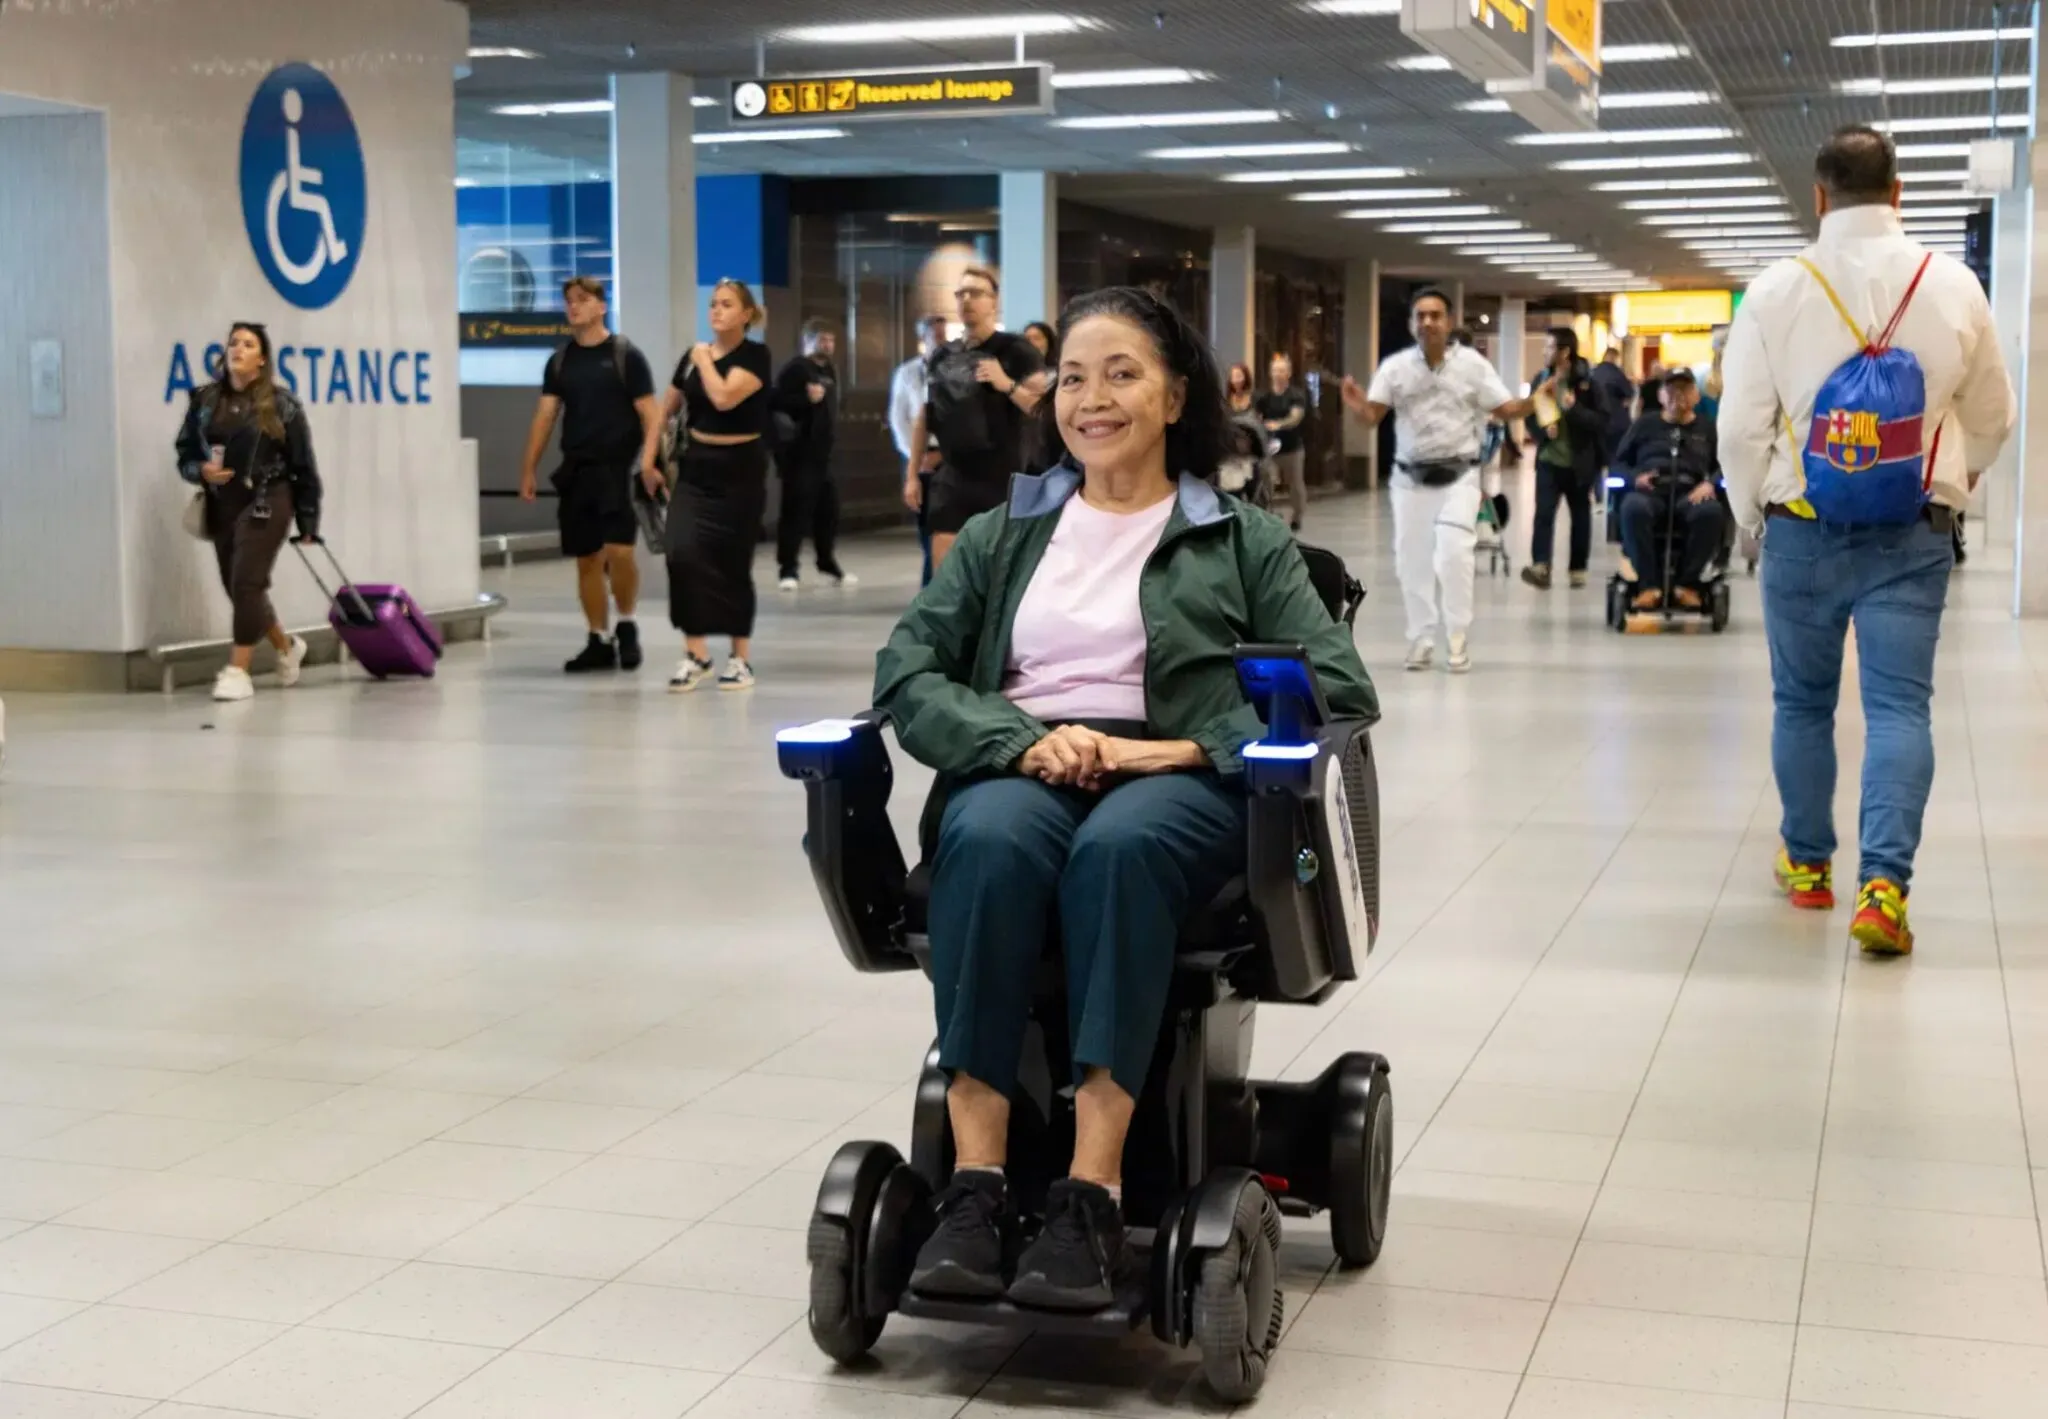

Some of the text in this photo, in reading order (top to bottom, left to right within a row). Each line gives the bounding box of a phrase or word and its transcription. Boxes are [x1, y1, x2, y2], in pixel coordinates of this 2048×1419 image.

[857, 79, 1014, 103] Reserved lounge
[164, 342, 431, 404] ASSTANCE
